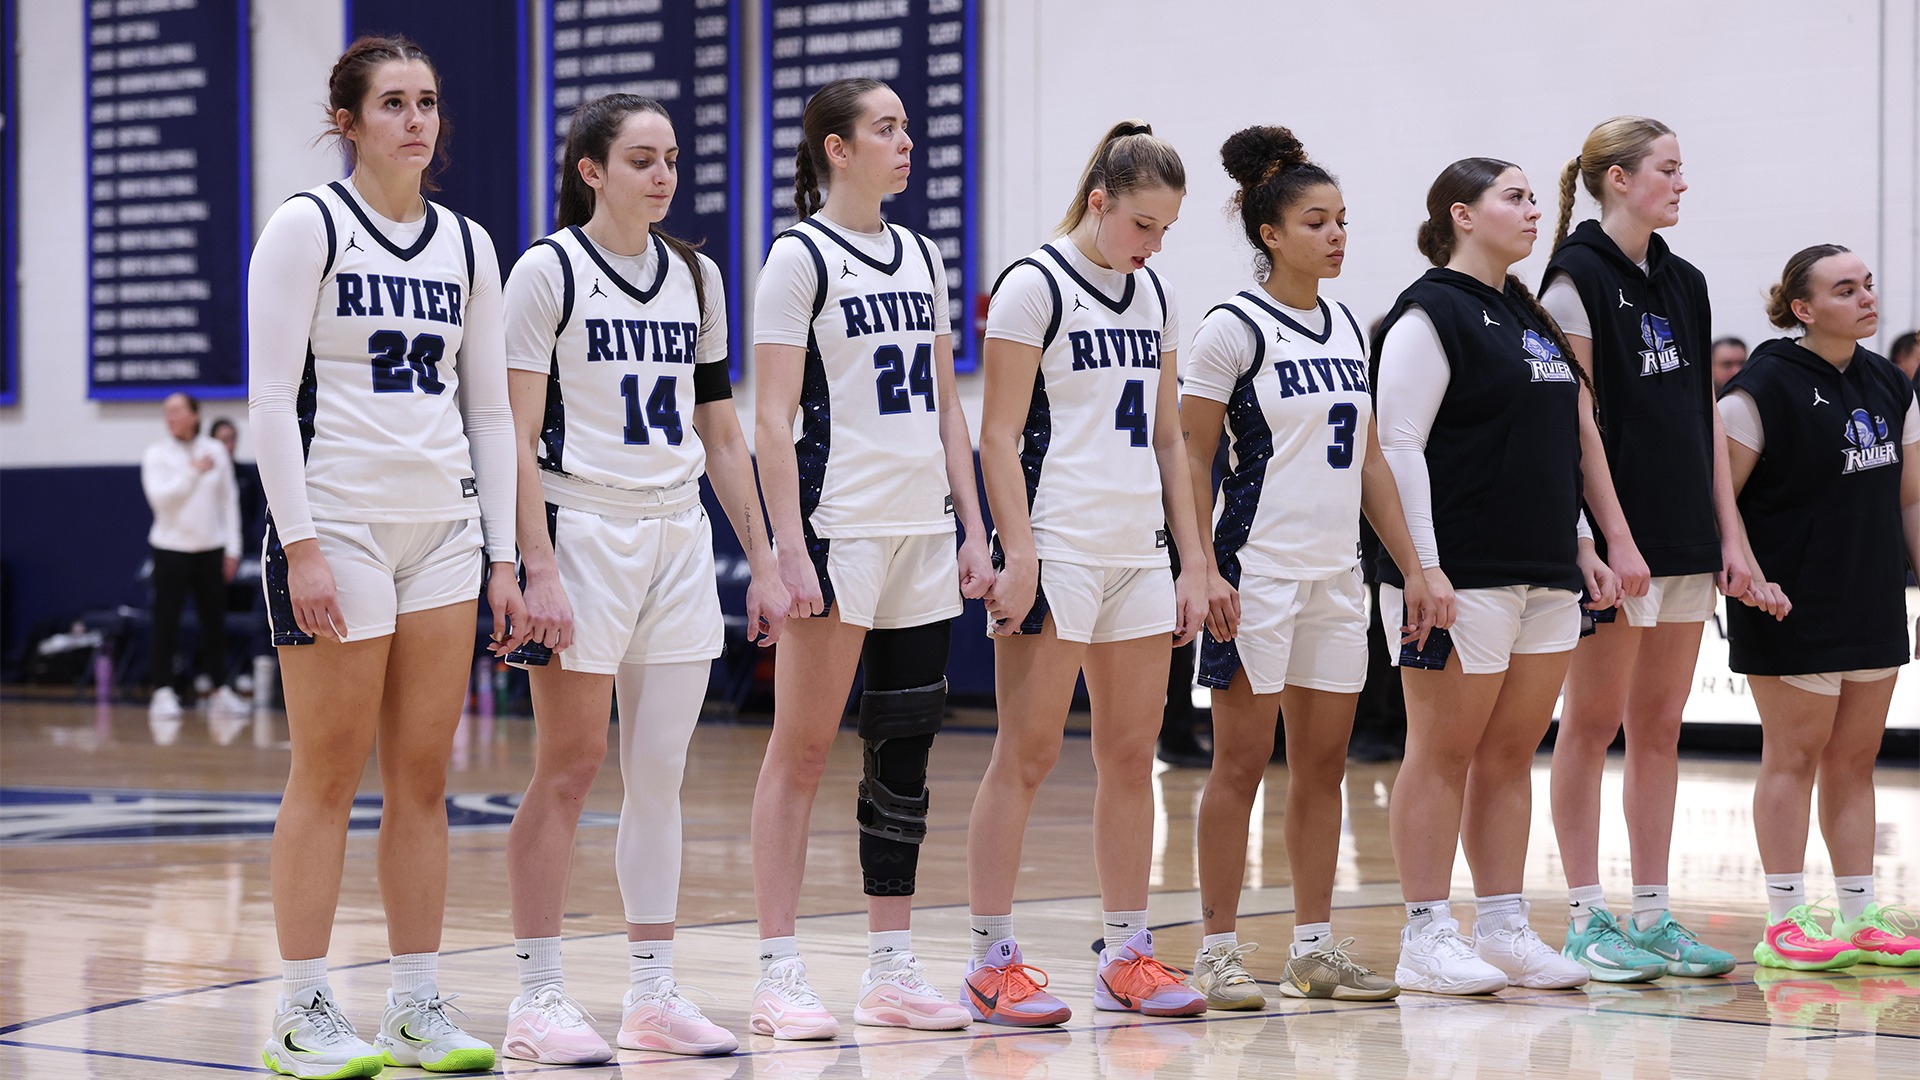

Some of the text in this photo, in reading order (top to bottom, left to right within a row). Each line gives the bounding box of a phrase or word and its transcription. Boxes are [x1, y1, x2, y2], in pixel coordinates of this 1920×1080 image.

[336, 272, 462, 327] RIVIER
[368, 329, 445, 395] 20
[585, 318, 698, 364] RIVIER
[1641, 346, 1683, 375] RVIE
[872, 343, 936, 415] 24
[1274, 357, 1371, 399] RIVIE
[1528, 359, 1577, 383] RIVIER
[620, 374, 684, 446] 14
[1115, 379, 1148, 448] 4
[1326, 402, 1358, 469] 3
[1844, 442, 1898, 472] RIVIER
